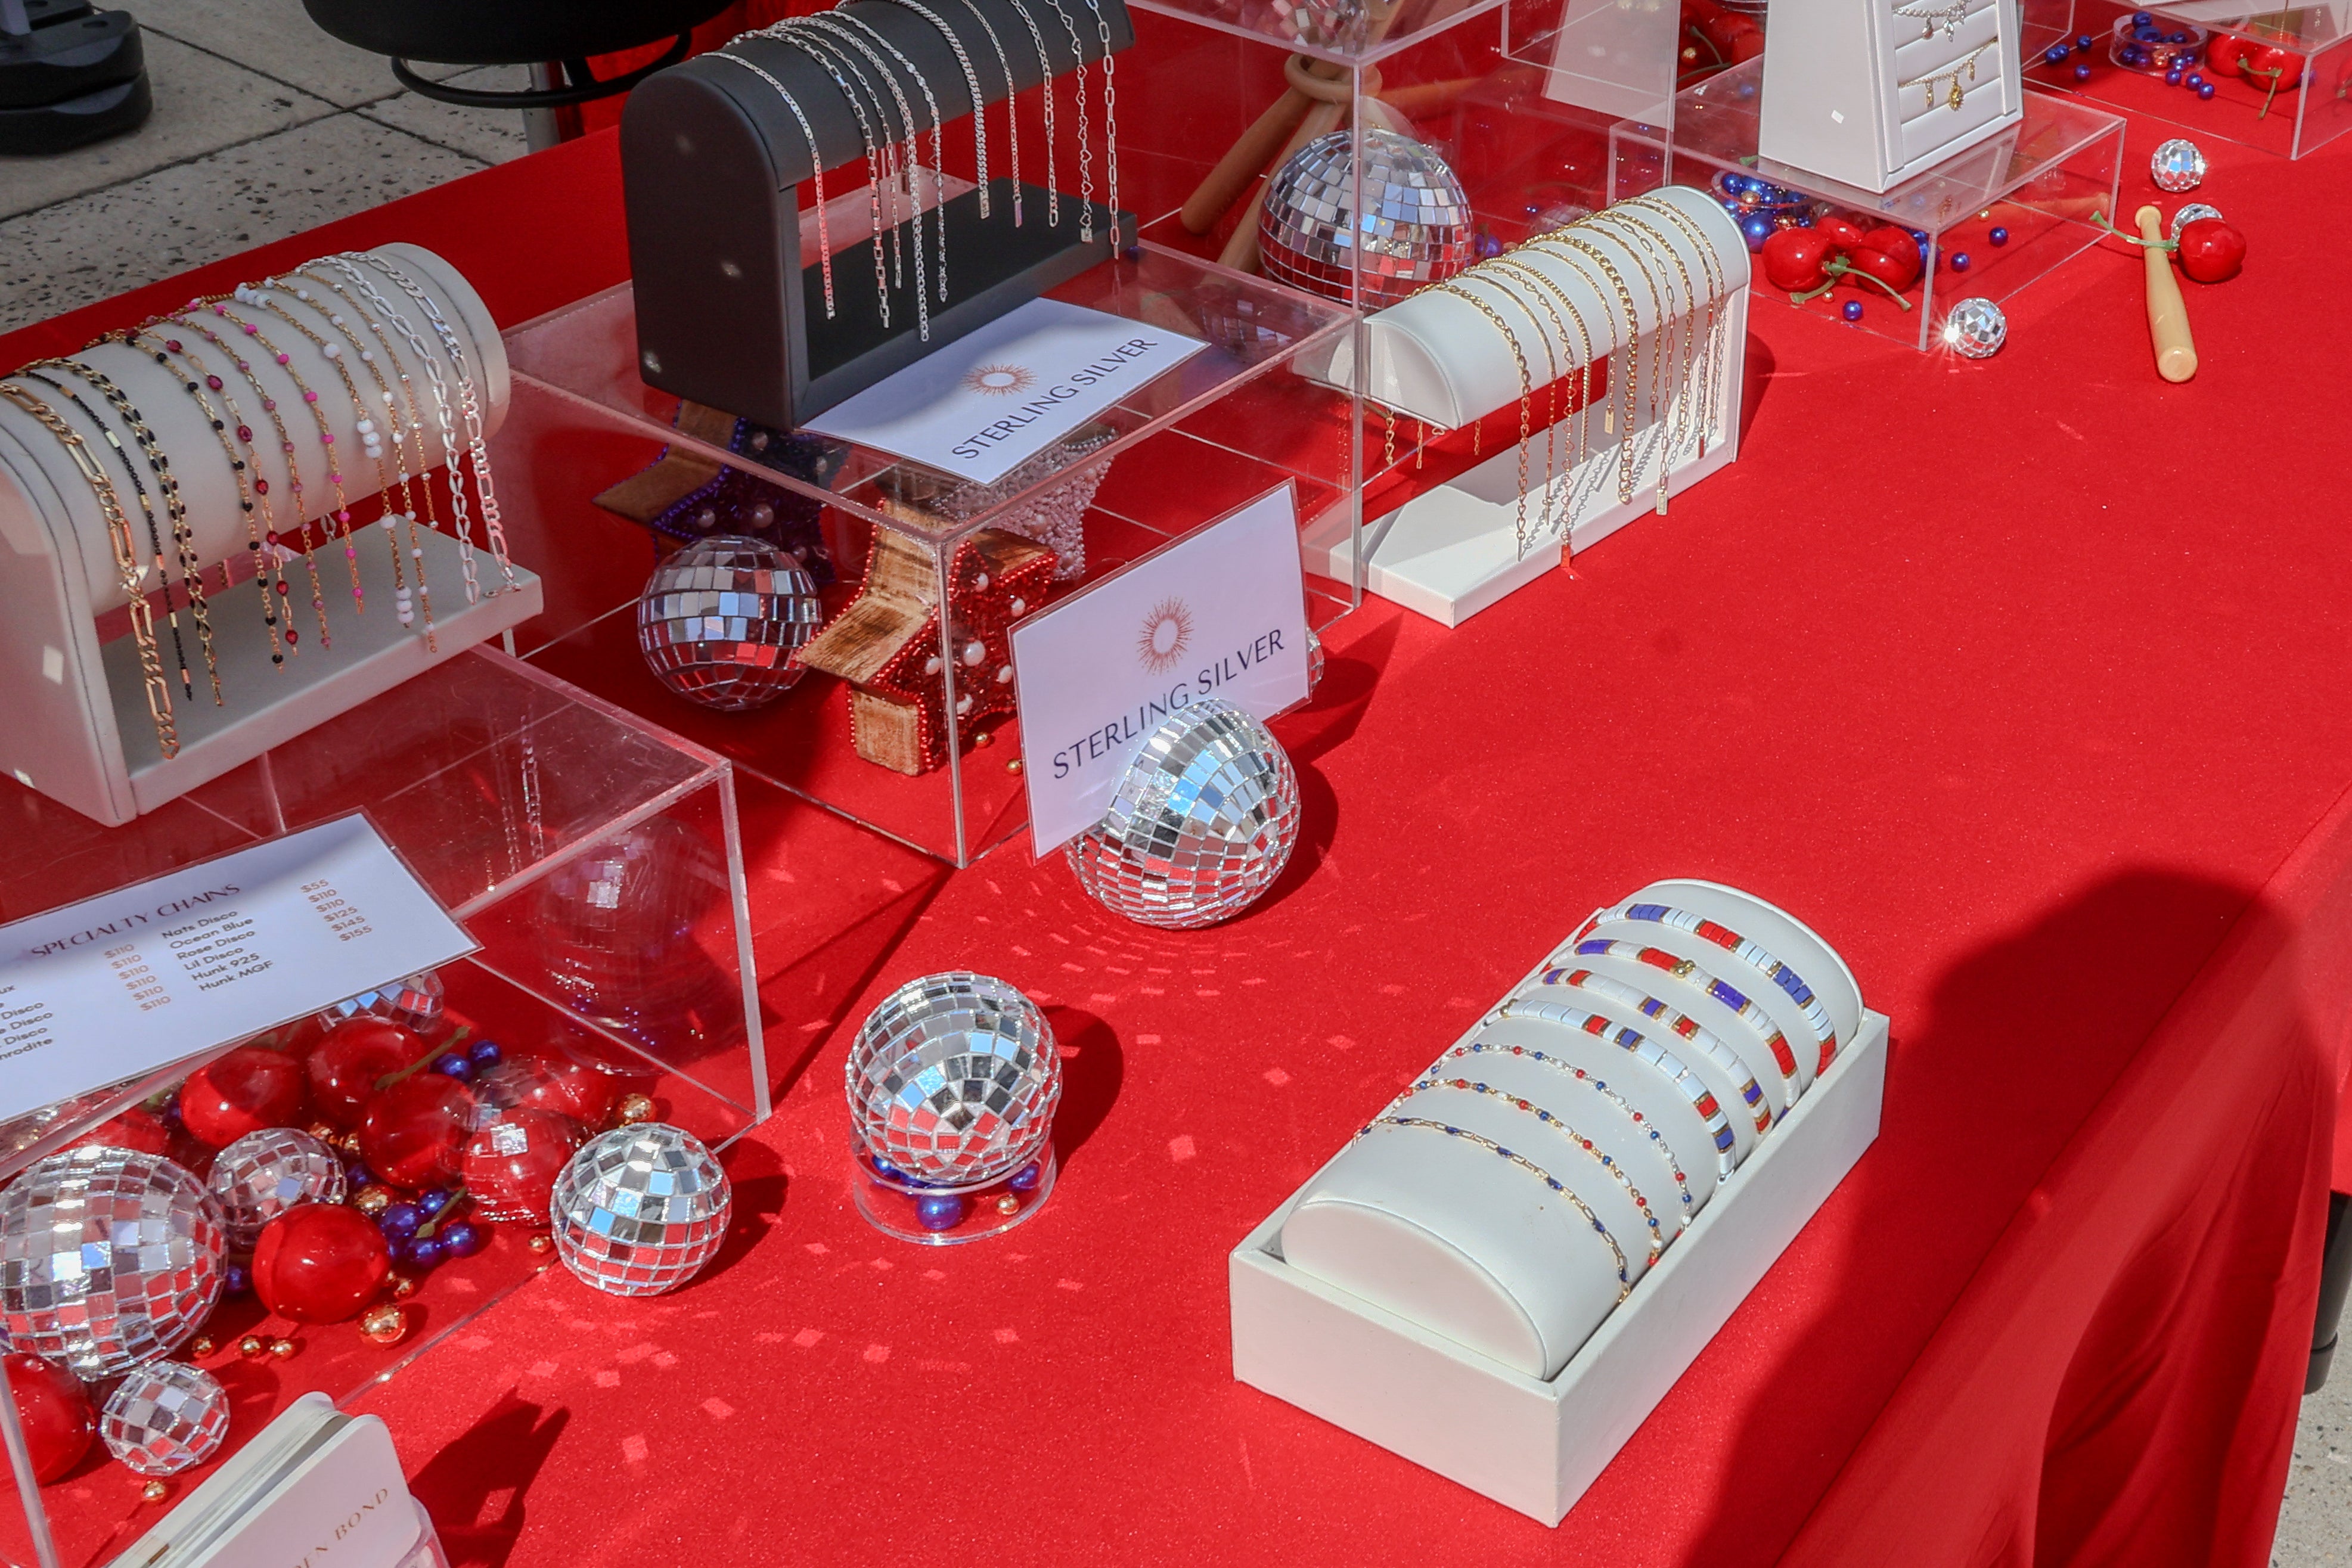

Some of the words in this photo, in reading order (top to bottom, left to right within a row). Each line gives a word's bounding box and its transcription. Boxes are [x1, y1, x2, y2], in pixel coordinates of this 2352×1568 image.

[952, 384, 1079, 459] STERLING
[1072, 337, 1158, 387] SILVER
[1053, 682, 1189, 779] STERLING
[1197, 629, 1284, 695] SILVER
[300, 879, 328, 893] $55
[309, 889, 337, 902] $110
[316, 899, 345, 912] $110
[324, 906, 358, 922] $125
[31, 912, 148, 958] SPECIALTY
[157, 883, 240, 917] CHAINS
[162, 926, 196, 938] Nats
[198, 911, 237, 927] Disco
[170, 930, 220, 949] Ocean
[222, 919, 253, 932] Blue
[339, 925, 372, 941] $155
[104, 944, 134, 958] $110
[177, 945, 212, 960] Rose
[215, 931, 255, 947] Disco
[111, 954, 141, 969] $110
[184, 960, 201, 970] Lil
[203, 948, 244, 964] Disco
[191, 964, 228, 980] Hunk
[229, 952, 259, 967] 925
[119, 965, 149, 979] $110
[126, 975, 156, 990] $110
[199, 974, 236, 991] Hunk
[133, 986, 163, 1000] $110
[1, 1002, 44, 1019] Disco
[140, 996, 171, 1011] $110
[10, 1013, 52, 1030] Disco
[4, 1027, 48, 1045] Disco
[294, 1541, 328, 1568] EN
[335, 1489, 387, 1540] BOND
